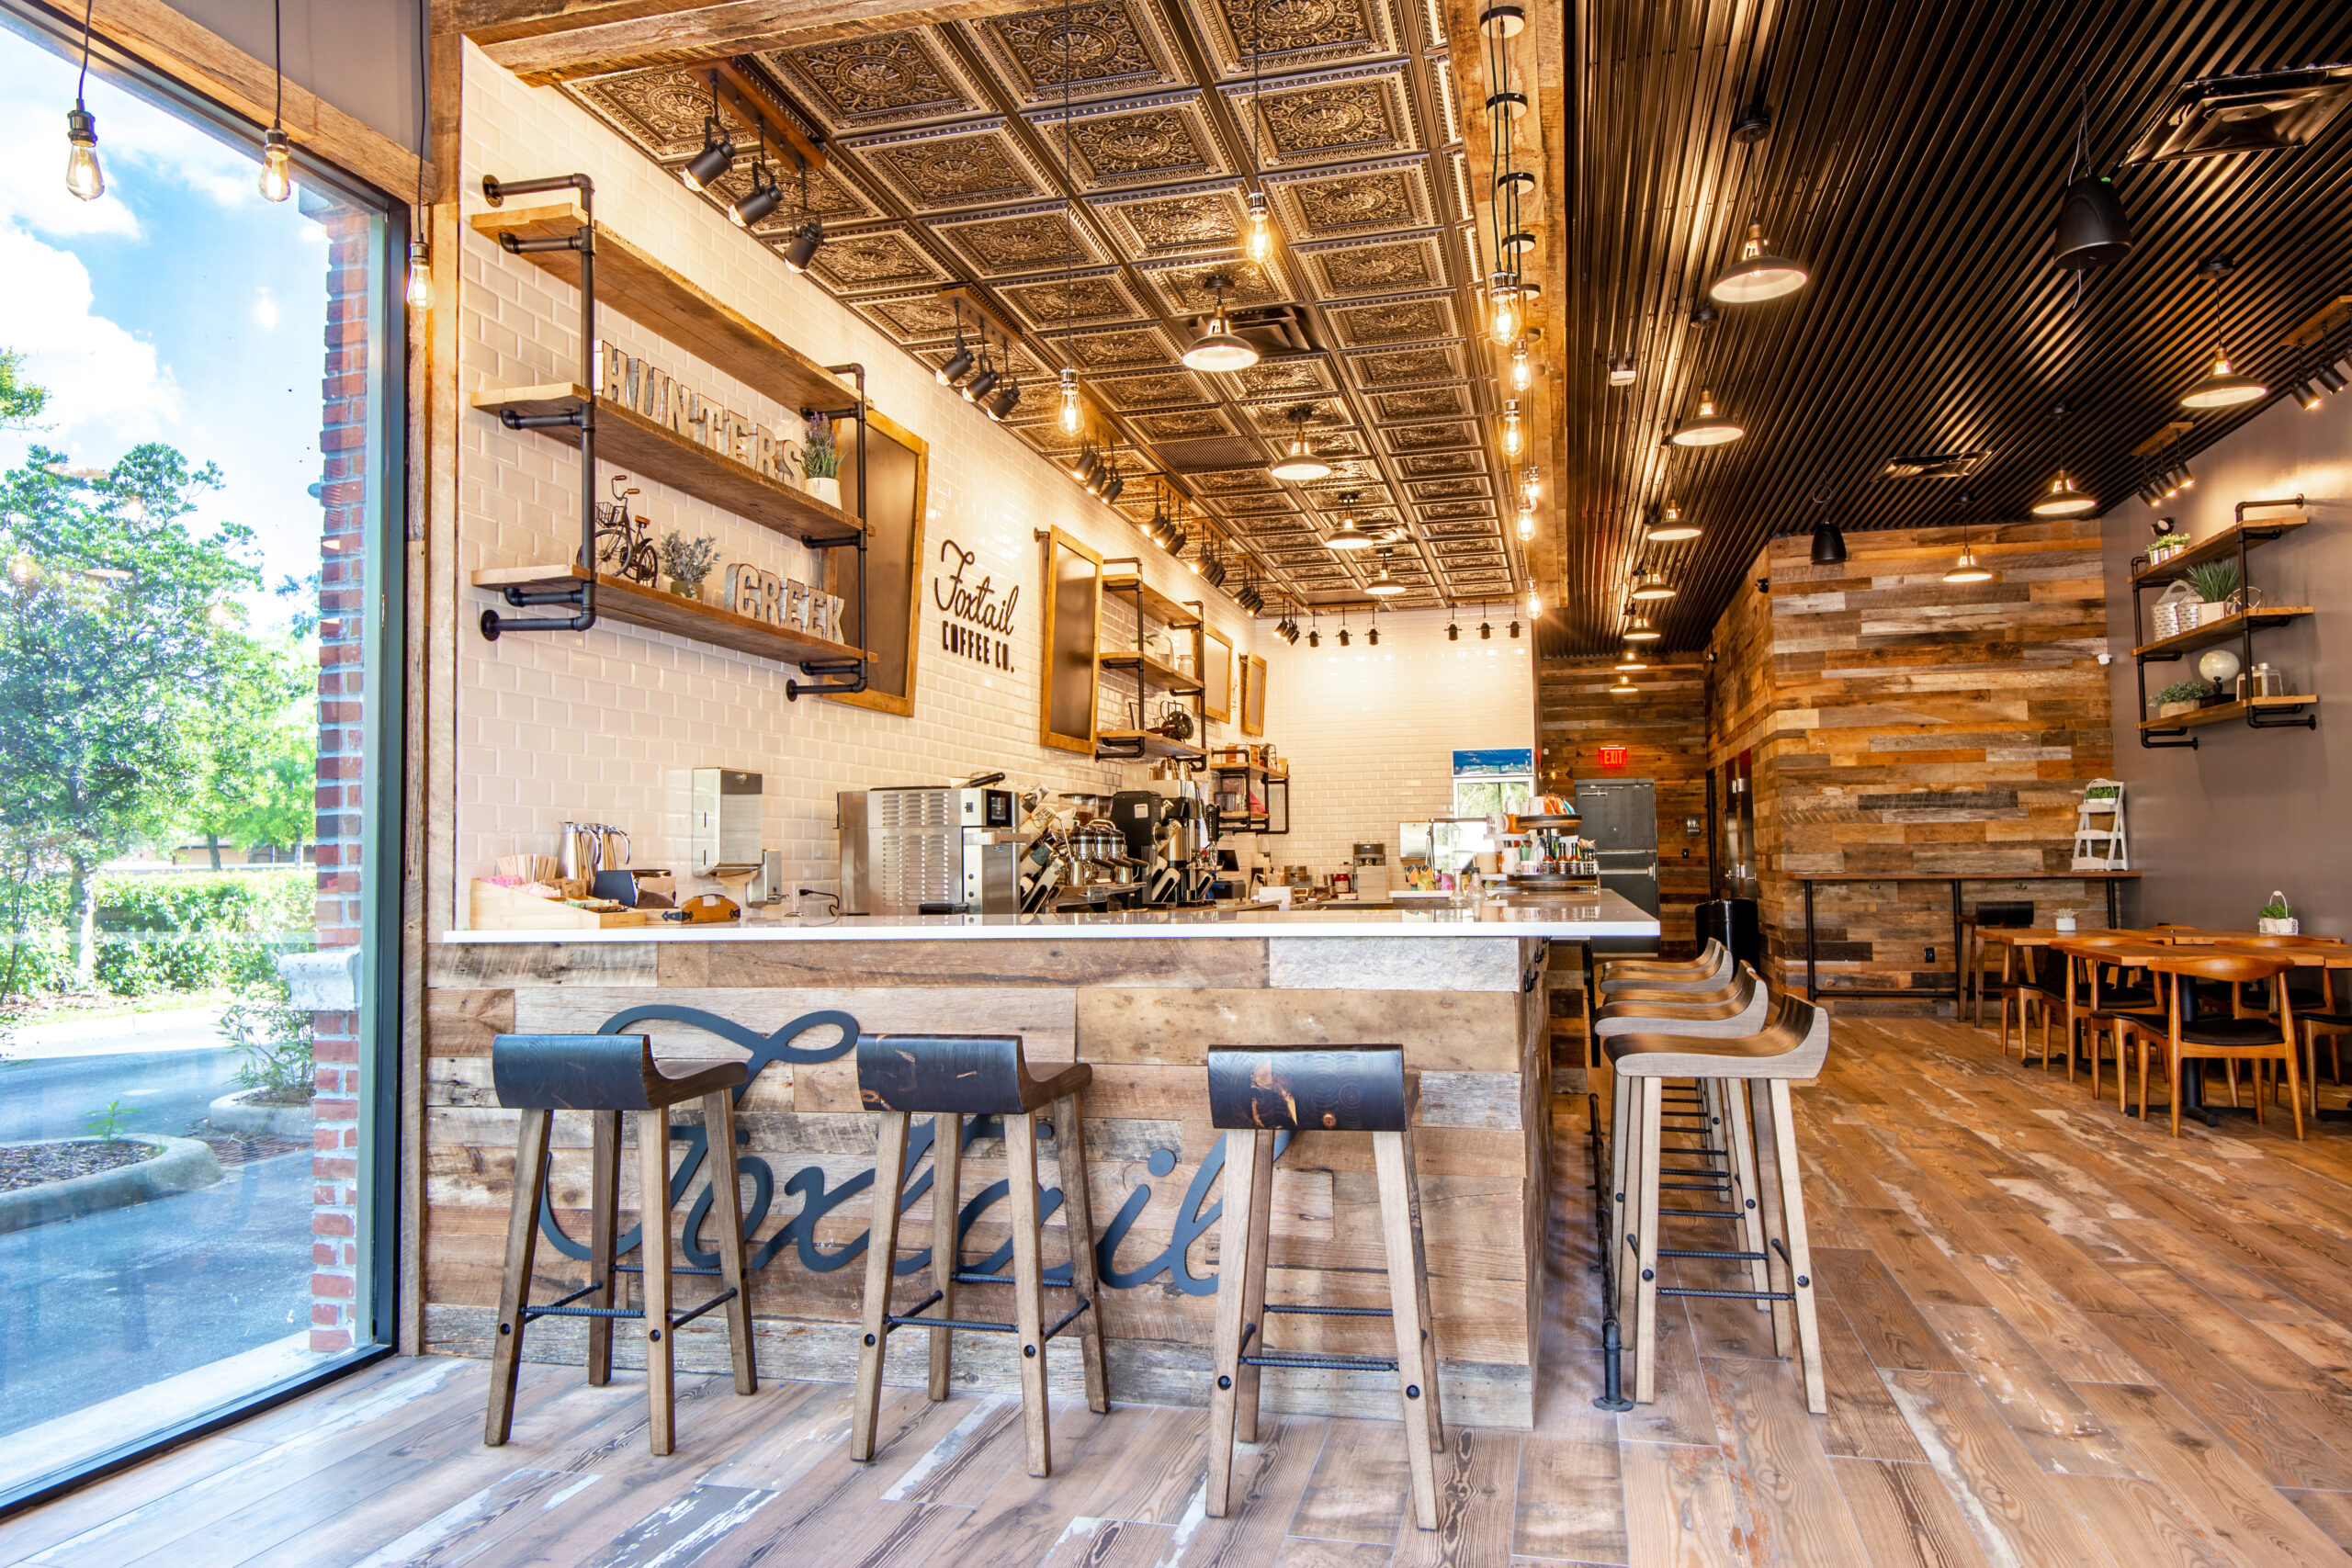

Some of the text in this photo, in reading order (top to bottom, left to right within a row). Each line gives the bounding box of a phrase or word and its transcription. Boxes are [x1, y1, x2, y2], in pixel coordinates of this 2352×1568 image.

[595, 339, 807, 492] HUNTERS
[726, 562, 845, 646] CREEK
[933, 538, 1020, 636] Foxtail
[942, 619, 1015, 673] COFFEE CO.
[1604, 750, 1623, 764] EXIT
